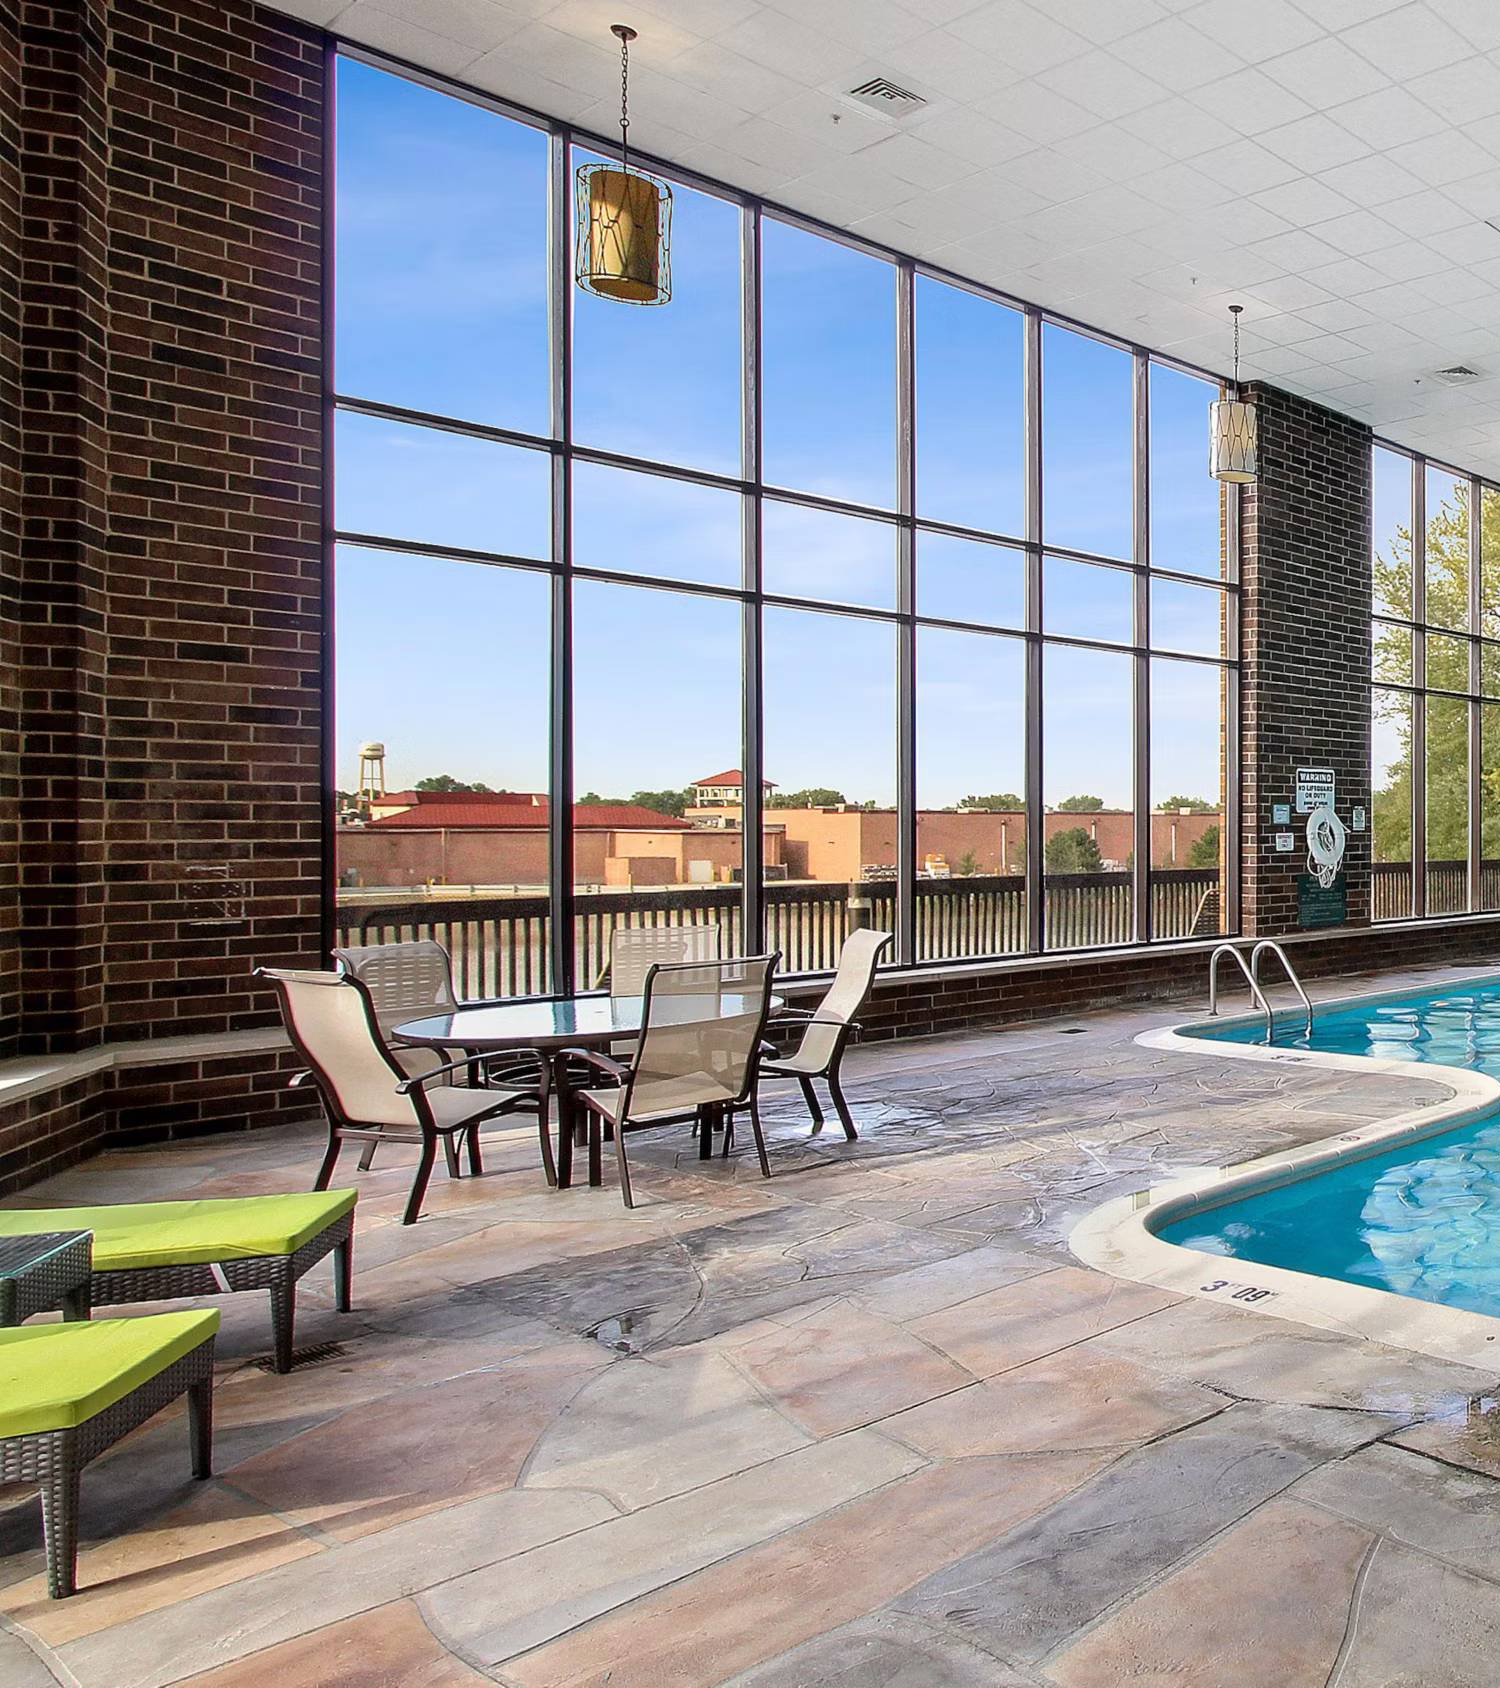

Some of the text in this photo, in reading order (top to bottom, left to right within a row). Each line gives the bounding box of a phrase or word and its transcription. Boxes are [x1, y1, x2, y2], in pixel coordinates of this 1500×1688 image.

[1300, 772, 1332, 782] WARNING
[1200, 1280, 1229, 1292] 3
[1232, 1287, 1270, 1302] 09
